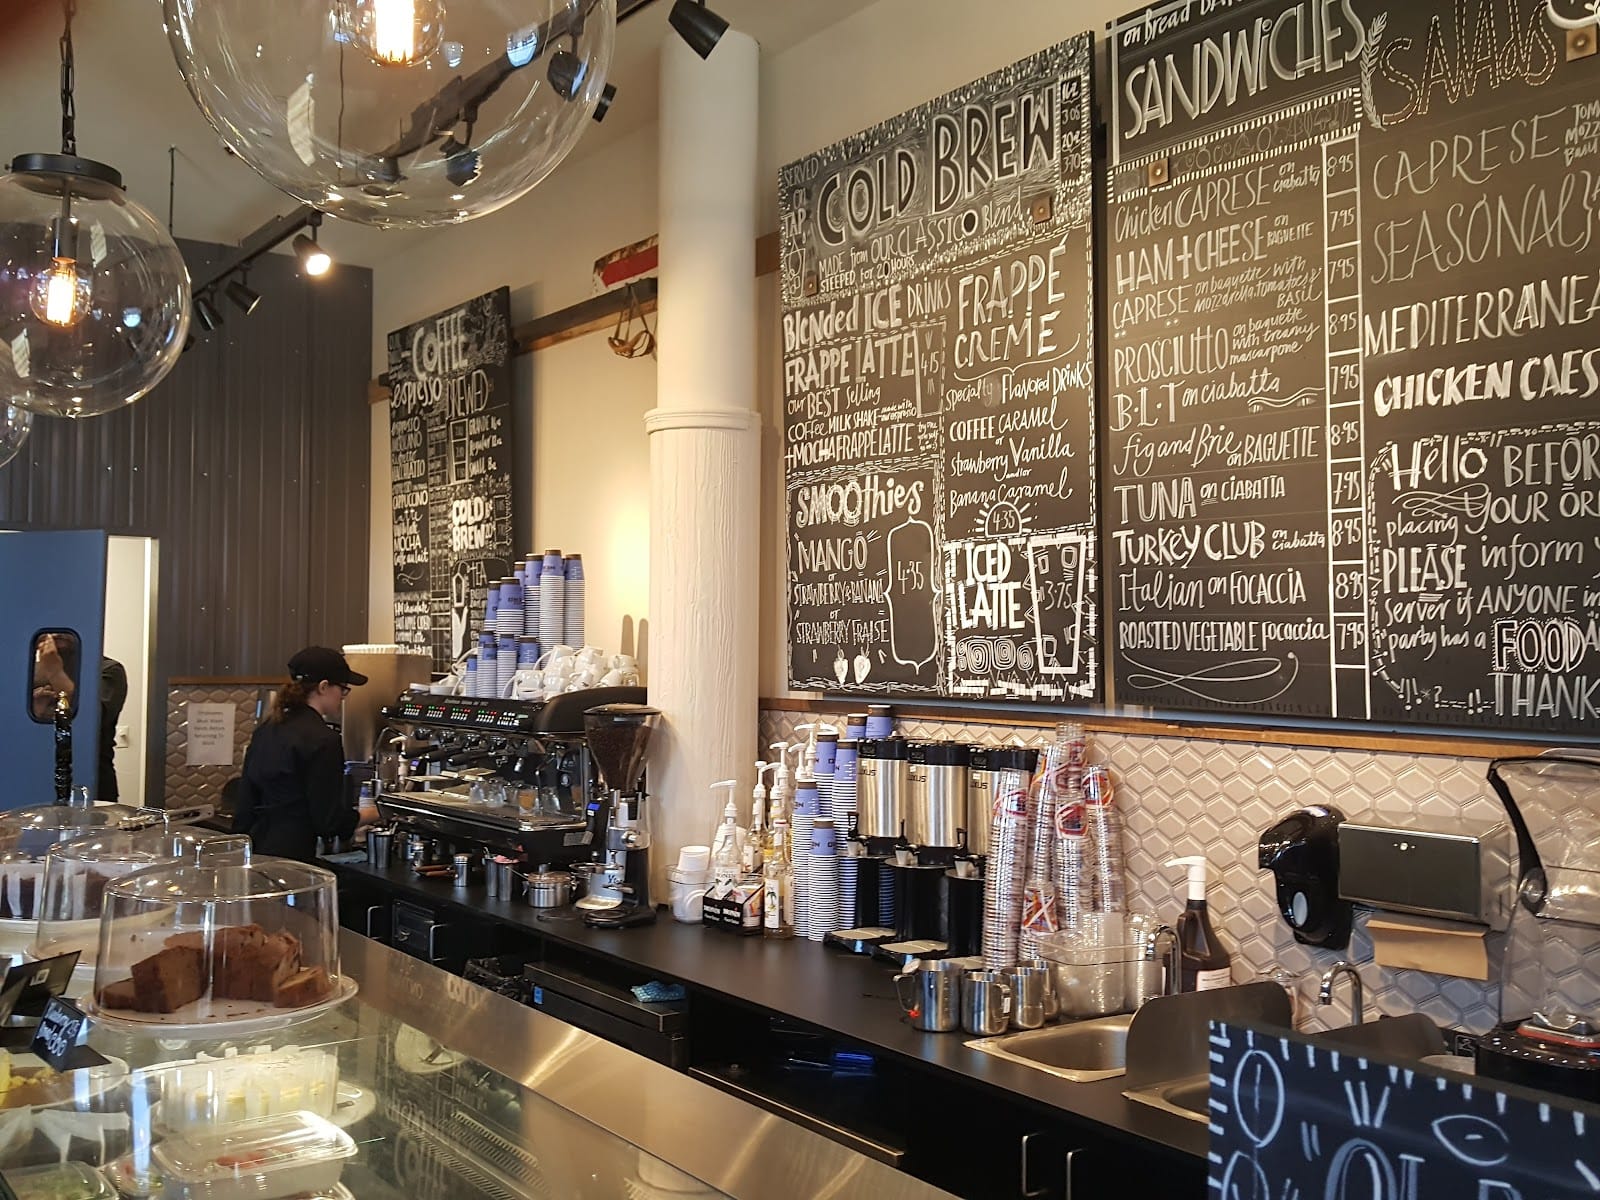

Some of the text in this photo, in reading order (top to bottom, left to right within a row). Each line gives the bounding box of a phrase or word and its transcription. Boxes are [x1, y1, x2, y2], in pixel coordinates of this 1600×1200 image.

[818, 149, 917, 247] COLD
[931, 83, 1059, 216] BREW
[1373, 106, 1568, 200] CAPRESE
[784, 157, 819, 188] SERVED
[1115, 161, 1295, 244] Chicken CAPRESE on
[1274, 214, 1289, 227] on
[1330, 207, 1355, 232] 7.95
[781, 207, 807, 239] TAP
[1267, 222, 1315, 247] BAGUETTE
[819, 251, 845, 281] MADE
[871, 234, 897, 263] OUR
[820, 270, 856, 293] STEEPED
[877, 261, 891, 279] 20
[891, 254, 915, 275] HOURS
[1329, 257, 1355, 284] 7.95
[864, 284, 903, 333] ICE
[1113, 284, 1192, 330] CAPRESE
[1195, 281, 1209, 296] on
[1272, 256, 1306, 277] with
[1232, 322, 1246, 337] on
[1232, 332, 1260, 350] with
[1329, 312, 1357, 336] 8.95
[785, 329, 917, 396] FRAPPE LATTE
[1331, 364, 1359, 395] 7.95
[1182, 387, 1202, 407] on
[1201, 367, 1281, 405] ciabatta
[1374, 348, 1600, 417] CHICKEN CAES
[808, 387, 840, 419] BEST
[828, 413, 852, 434] MILK
[853, 408, 880, 429] SHAKE
[950, 415, 996, 442] COFFEE
[1009, 432, 1075, 467] Vanilla
[1114, 433, 1155, 477] fig
[1157, 428, 1196, 457] and
[1227, 451, 1242, 466] on
[1243, 426, 1321, 466] BAGUETTE
[1389, 435, 1488, 491] Hello
[998, 466, 1073, 502] Caramel
[1113, 477, 1197, 524] TUNA
[1333, 470, 1361, 505] 7.95
[452, 524, 486, 552] BREW
[1332, 518, 1361, 547] 8.95
[1386, 512, 1459, 549] placing
[1559, 490, 1600, 517] OR
[798, 536, 868, 574] MANGO
[1203, 520, 1266, 560] CLUB
[1272, 529, 1288, 540] on
[897, 561, 924, 595] 4.35
[966, 543, 1012, 584] ICED
[1383, 545, 1468, 594] PLEASE
[1481, 533, 1584, 580] inform
[1119, 568, 1204, 612] Italian
[1208, 576, 1227, 595] on
[1335, 571, 1364, 600] 8.95
[957, 581, 1026, 631] LATTE
[1385, 598, 1451, 627] server
[1457, 588, 1474, 626] if
[1476, 583, 1578, 614] ANYONE
[796, 618, 890, 646] STRAWBERRY FRAISE
[1119, 621, 1181, 650] ROASTED
[1182, 621, 1260, 652] VEGETABLE
[1336, 623, 1365, 650] 7.95
[1388, 625, 1437, 663] party
[1440, 625, 1469, 648] has
[1474, 631, 1487, 649] a
[1493, 618, 1586, 673] FOOD
[1488, 673, 1600, 720] THANK
